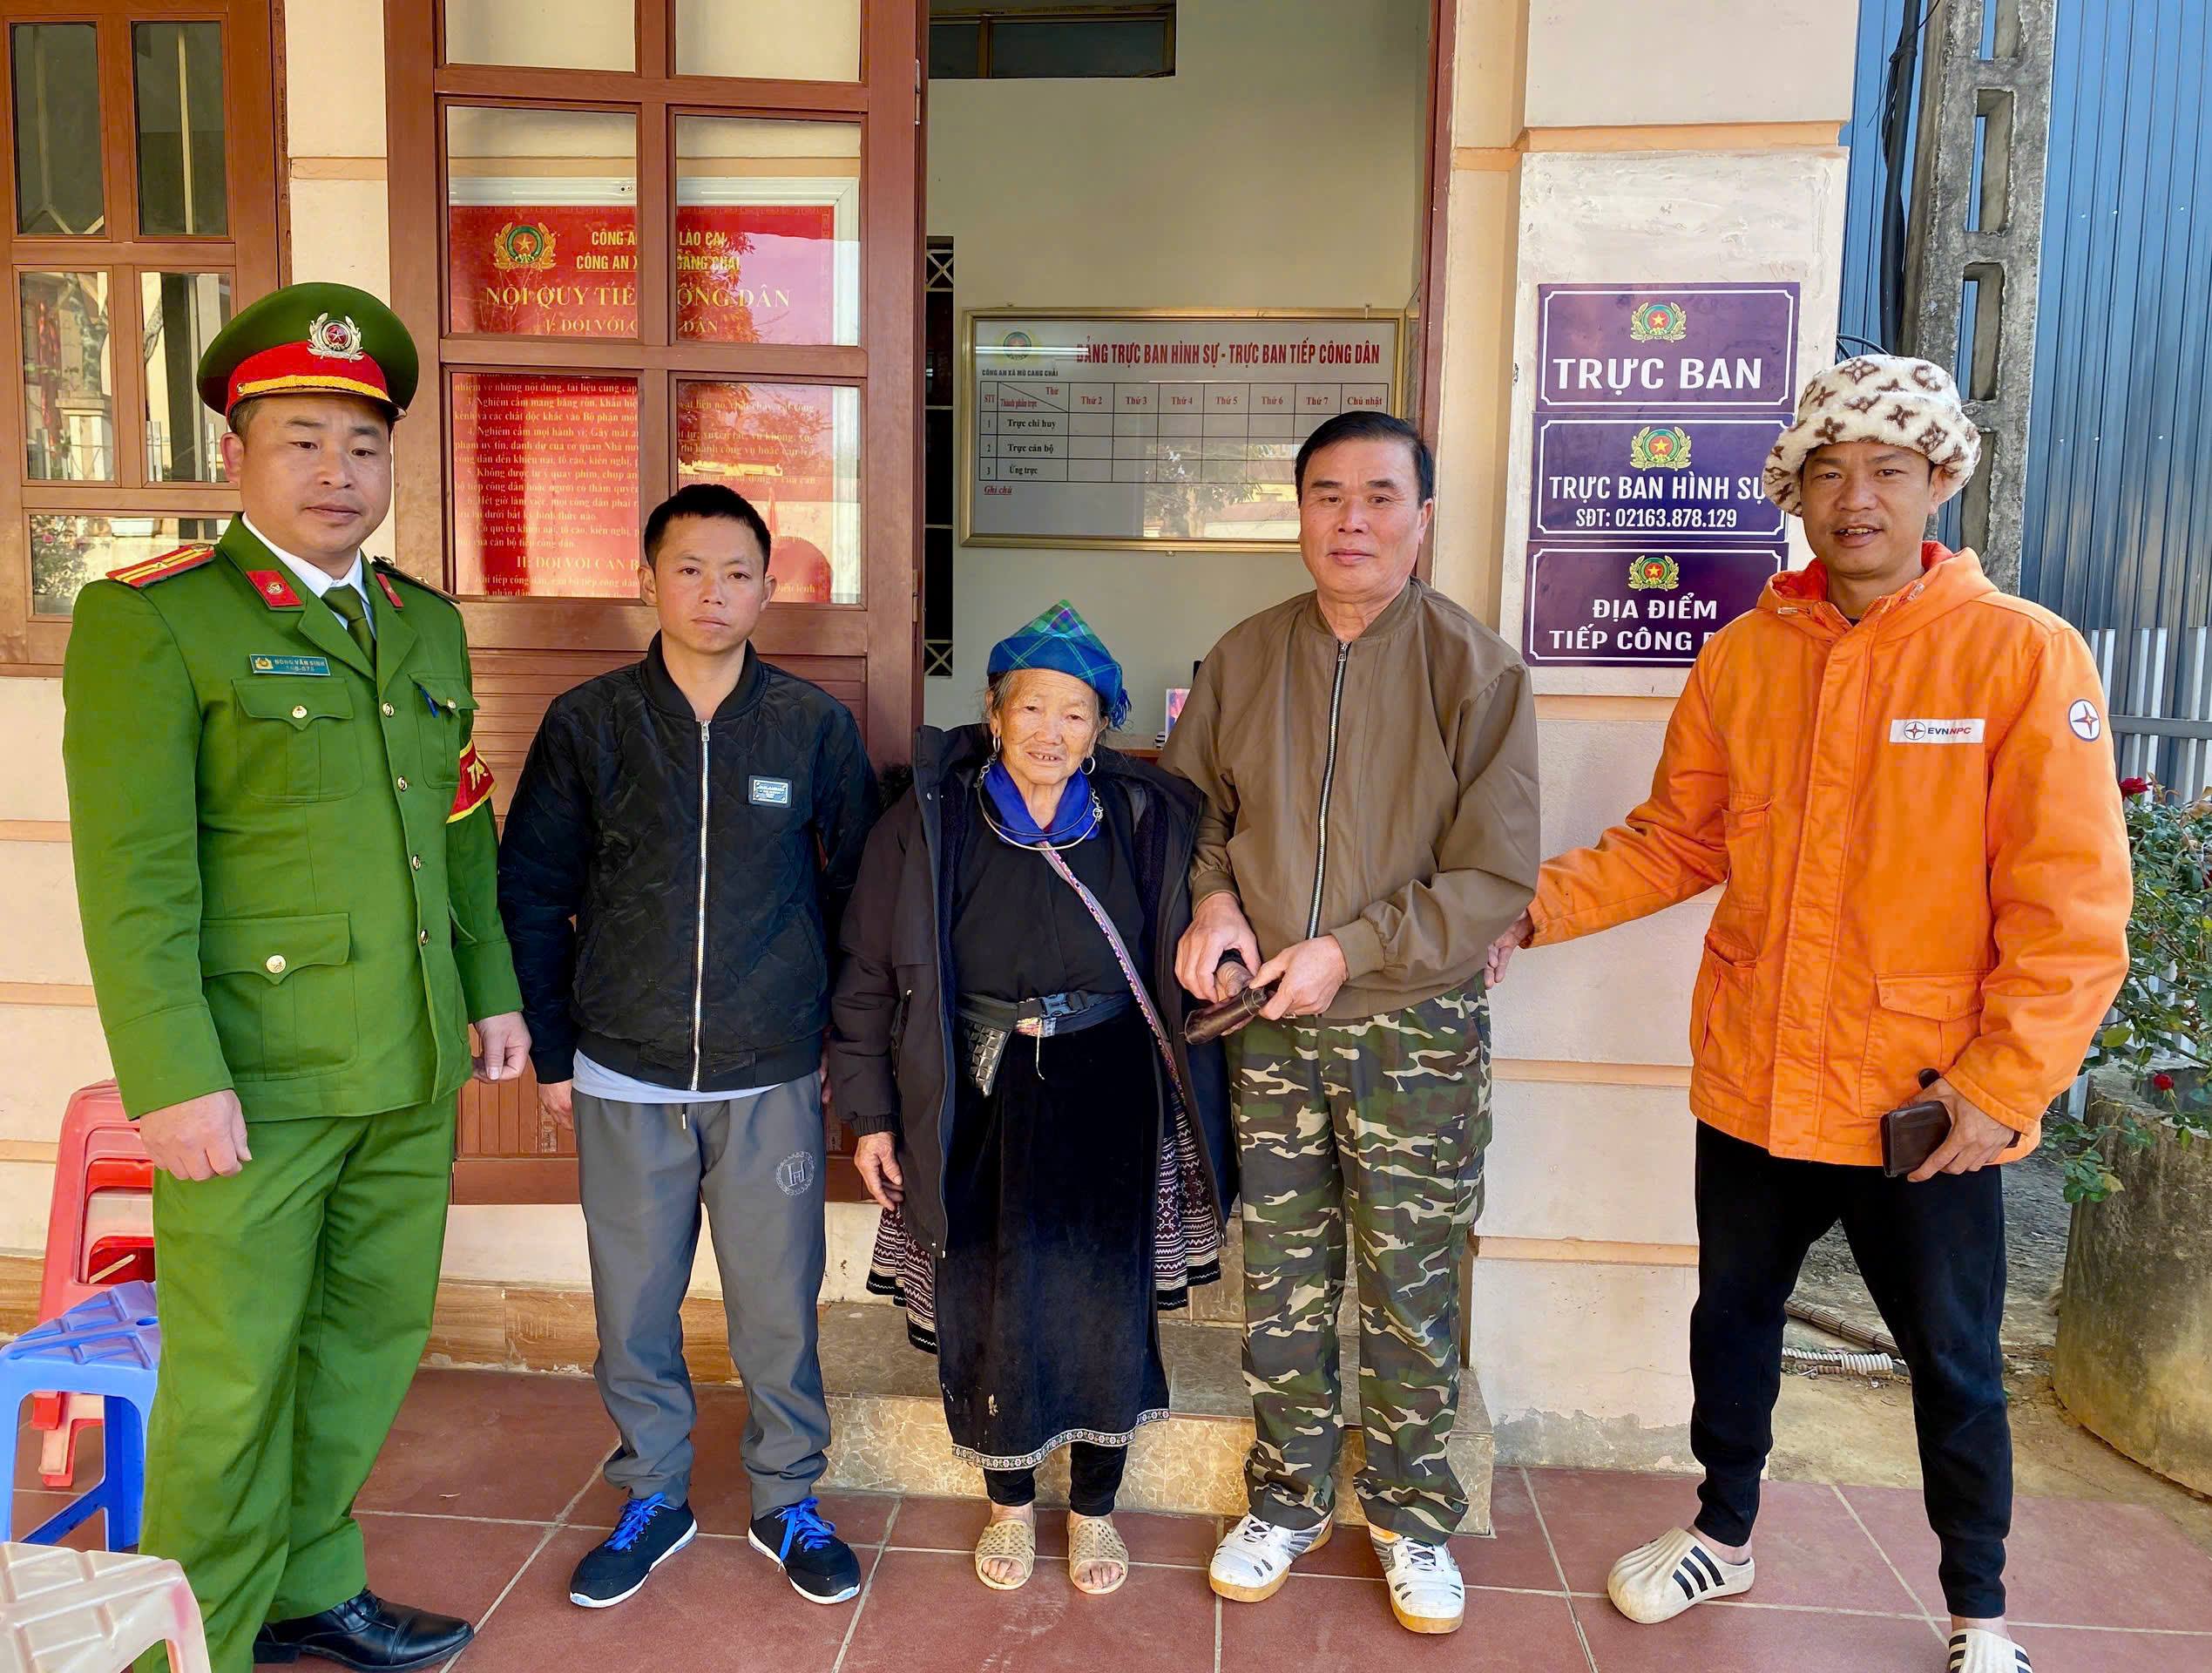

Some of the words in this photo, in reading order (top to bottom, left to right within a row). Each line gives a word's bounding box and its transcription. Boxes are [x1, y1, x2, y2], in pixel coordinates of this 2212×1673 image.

[592, 228, 624, 246] CÔNG
[679, 228, 701, 246] LÀO
[576, 252, 609, 270] CÔNG
[612, 255, 629, 270] AN
[485, 283, 529, 310] NỘI
[537, 286, 590, 309] QUY
[594, 279, 637, 306] TIẾ
[677, 282, 730, 308] ÔNG
[738, 283, 790, 308] DÂN
[683, 316, 719, 333] DÂN
[1111, 342, 1141, 368] TRỰC
[1144, 343, 1168, 364] BAN
[1171, 340, 1200, 364] HÌNH
[1202, 342, 1221, 368] SỰ
[1228, 342, 1260, 368] TRỰC
[1262, 343, 1287, 364] BAN
[1289, 337, 1316, 364] TIẾP
[1319, 340, 1352, 364] CÔNG
[1355, 340, 1380, 364] DÂN
[1552, 357, 1665, 396] TRỰC
[1680, 358, 1762, 389] BAN
[984, 394, 995, 403] STT
[1080, 396, 1097, 405] Thứ
[1098, 396, 1103, 405] 2
[1126, 396, 1141, 405] Thứ
[1142, 396, 1147, 405] 3
[1171, 396, 1187, 405] Thứ
[1187, 396, 1193, 405] 4
[1216, 396, 1232, 405] Thứ
[1233, 396, 1238, 405] 5
[1262, 396, 1277, 405] Thứ
[1278, 396, 1283, 405] 6
[1306, 396, 1322, 405] Thứ
[1323, 396, 1329, 405] 7
[1347, 396, 1363, 406] Chủ
[1365, 396, 1383, 408] nhật
[1007, 418, 1026, 429] Trực
[1042, 419, 1056, 430] huy
[987, 444, 991, 452] 2
[1007, 444, 1026, 454] Trực
[1028, 444, 1042, 452] cán
[1044, 444, 1054, 454] bộ
[986, 466, 991, 475] 3
[1025, 467, 1038, 477] trực
[984, 484, 998, 495] Ghi
[1548, 476, 1611, 504] TRỰC
[1618, 477, 1663, 500] BAN
[1671, 471, 1729, 500] HÌNH
[1575, 508, 1611, 527] SĐT:
[1615, 508, 1737, 527] 02163.878.129
[1593, 599, 1639, 622] ĐỊA
[1647, 593, 1717, 620] ĐIỂM
[1549, 623, 1608, 650] TIẾP
[1617, 627, 1693, 651] CÔNG
[1927, 726, 1972, 735] EVNNPC
